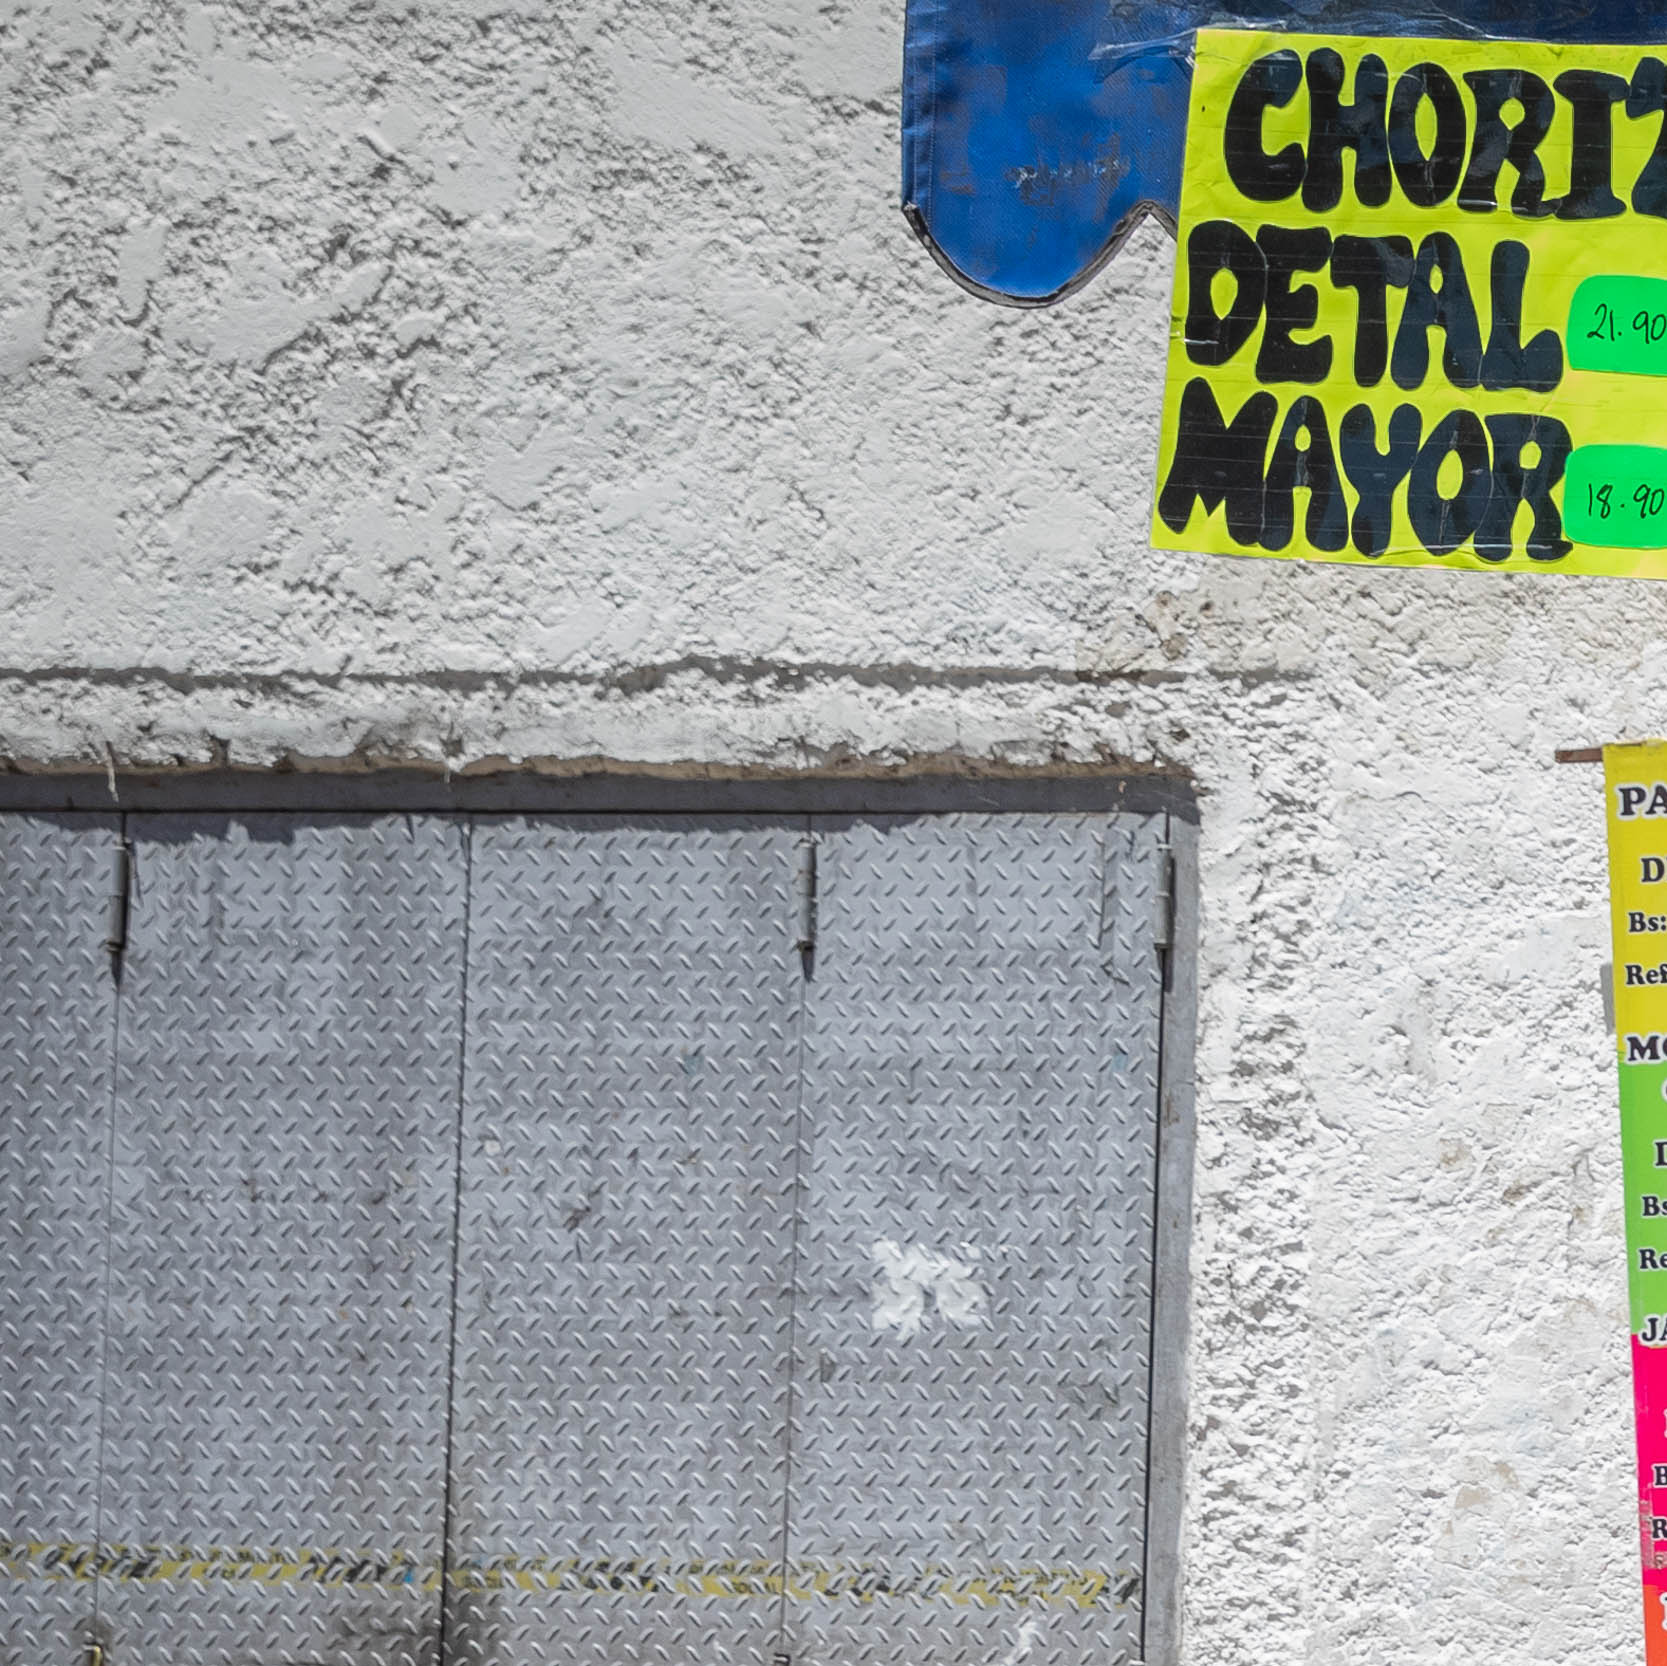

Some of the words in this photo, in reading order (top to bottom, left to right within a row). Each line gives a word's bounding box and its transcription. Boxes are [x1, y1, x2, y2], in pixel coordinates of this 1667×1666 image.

[1186, 220, 1563, 392] DETAL
[1158, 377, 1573, 561] MAYOR
[1587, 485, 1665, 518] 18.90
